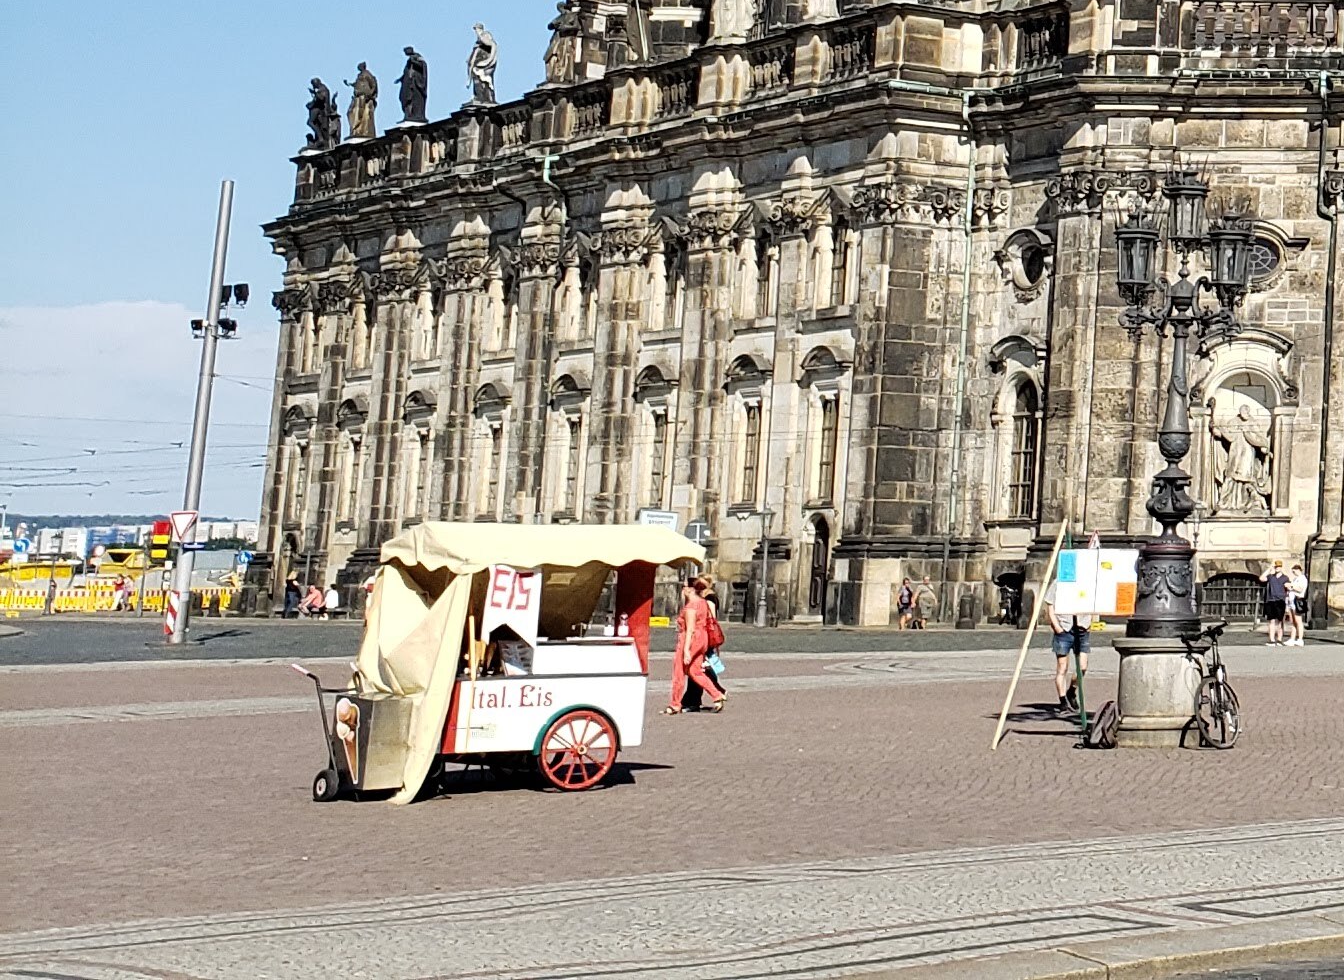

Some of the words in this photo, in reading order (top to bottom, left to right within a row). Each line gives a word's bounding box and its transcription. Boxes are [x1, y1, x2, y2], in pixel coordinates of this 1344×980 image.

[491, 568, 534, 610] EIS
[471, 686, 512, 710] Ital.
[518, 684, 553, 708] Eis
